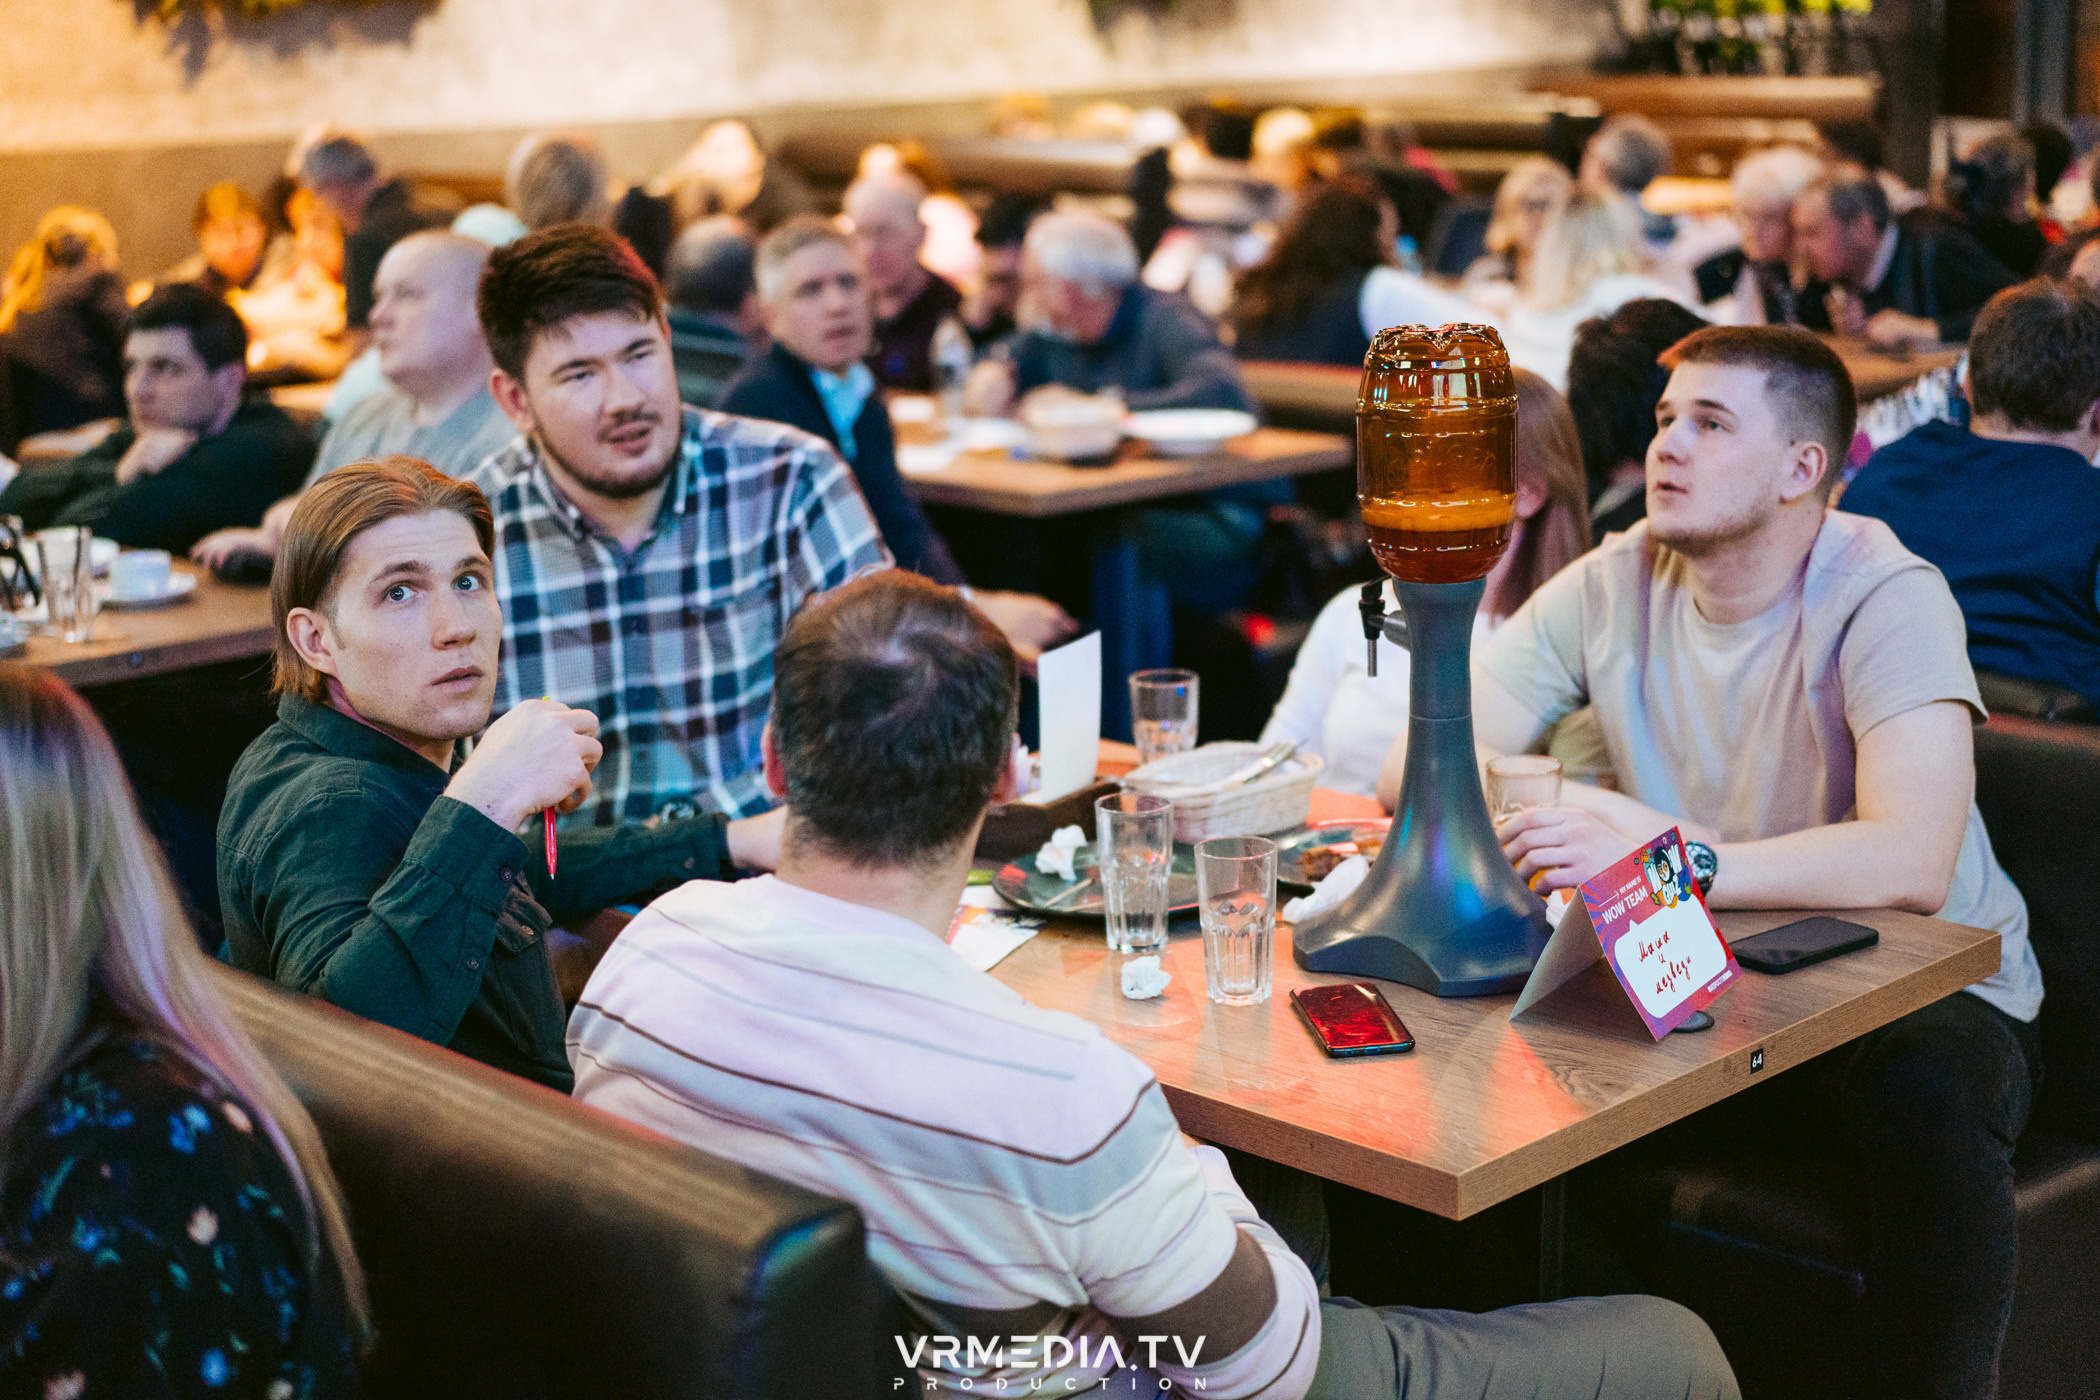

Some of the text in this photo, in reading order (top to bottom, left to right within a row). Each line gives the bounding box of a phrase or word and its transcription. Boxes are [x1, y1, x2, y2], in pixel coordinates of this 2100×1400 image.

[1619, 885, 1627, 894] MY
[1625, 877, 1638, 890] NAME
[1662, 873, 1682, 905] QUIZ
[1602, 885, 1649, 924] WOW TEAM
[1638, 930, 1670, 963] Маша
[1658, 952, 1666, 964] и
[1752, 1053, 1763, 1068] 64
